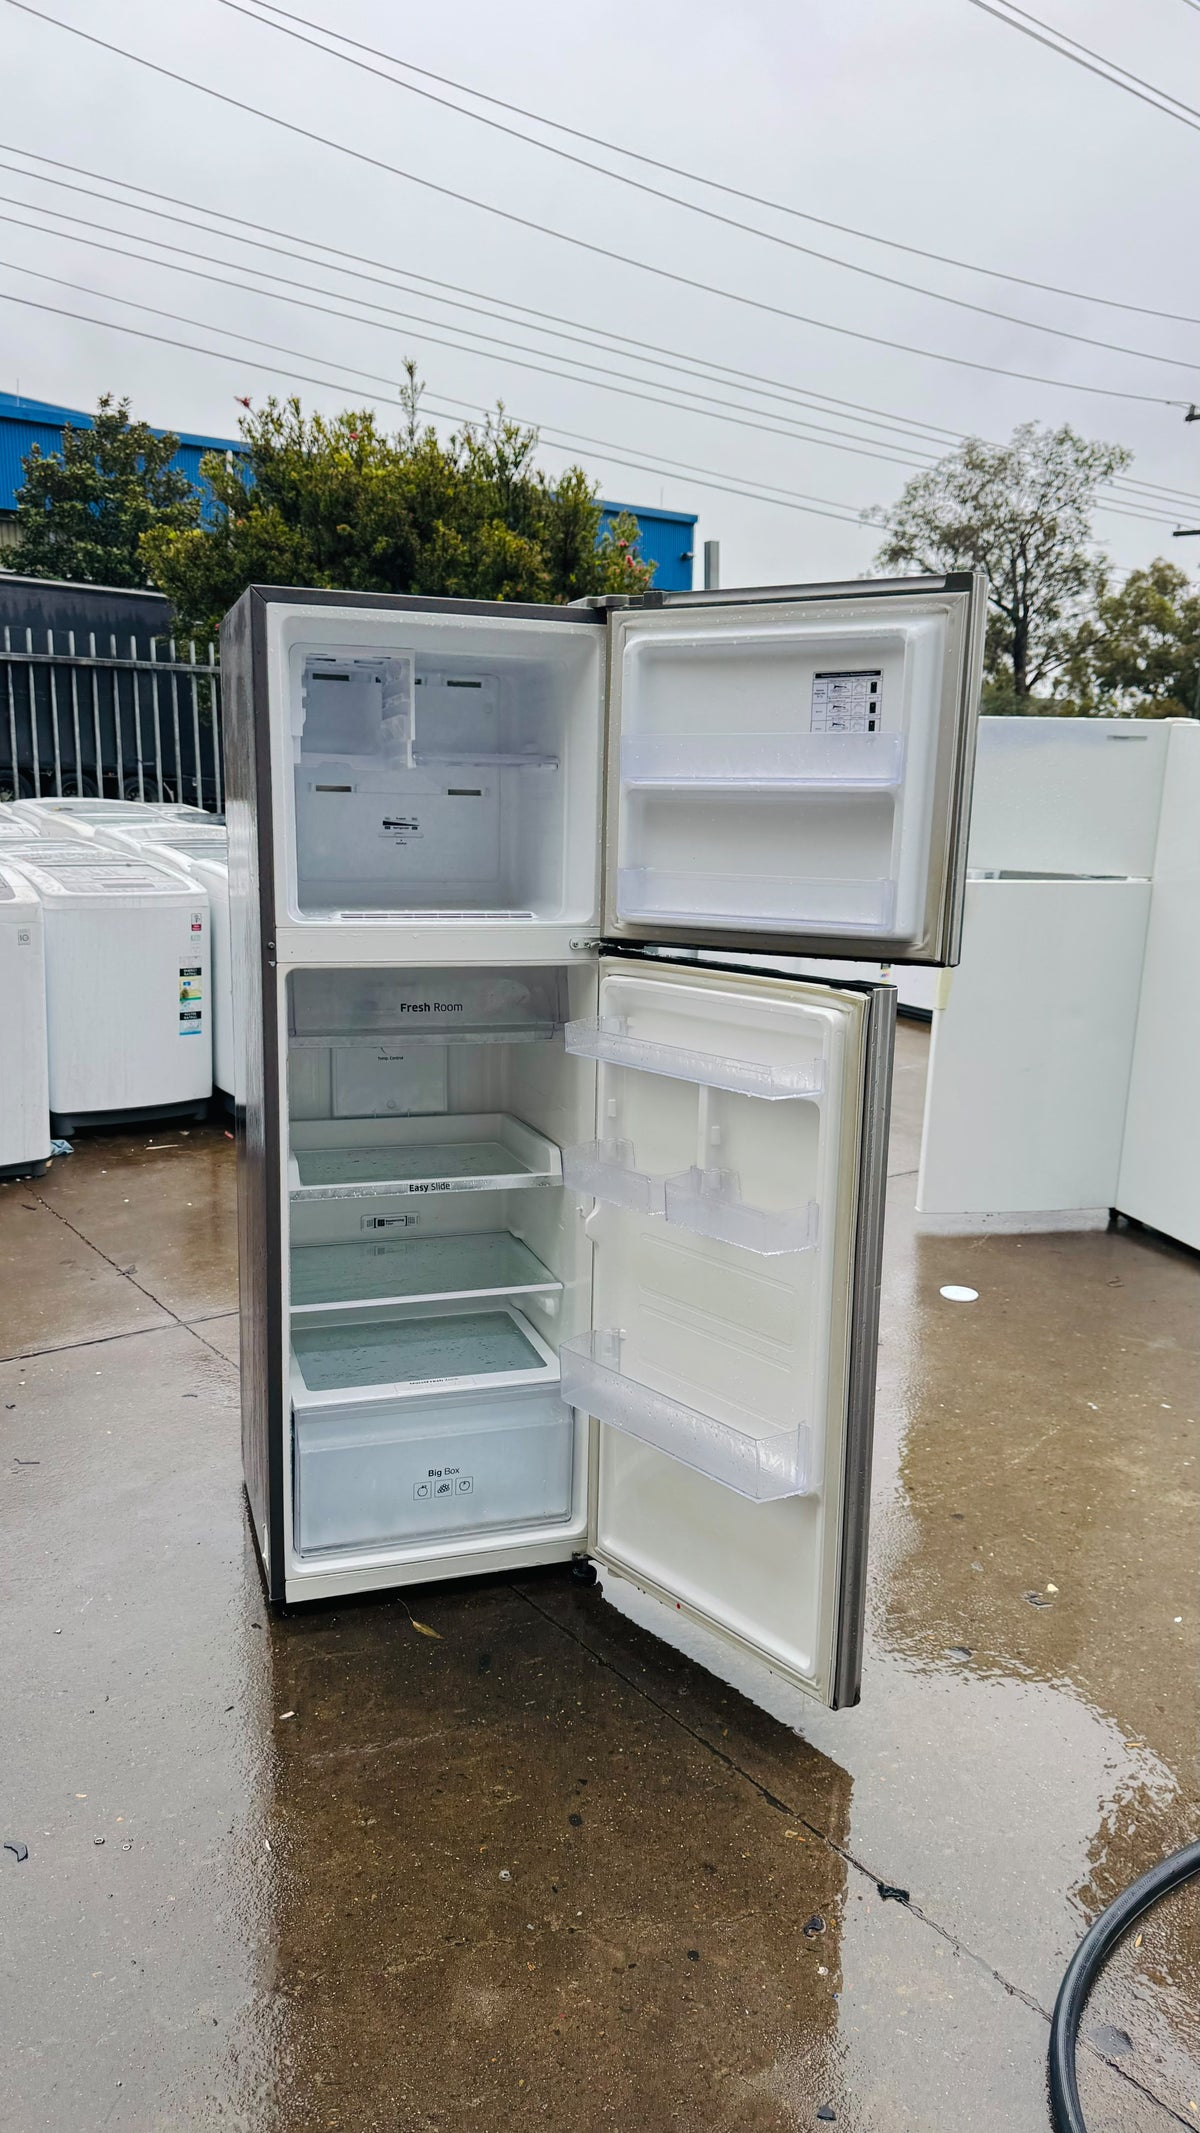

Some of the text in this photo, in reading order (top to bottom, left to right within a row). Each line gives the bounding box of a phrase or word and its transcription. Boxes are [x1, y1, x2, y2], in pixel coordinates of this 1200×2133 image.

[400, 1002, 463, 1013] Fresh Room
[409, 1182, 451, 1193] Easy Slide
[428, 1467, 460, 1478] Big Box
